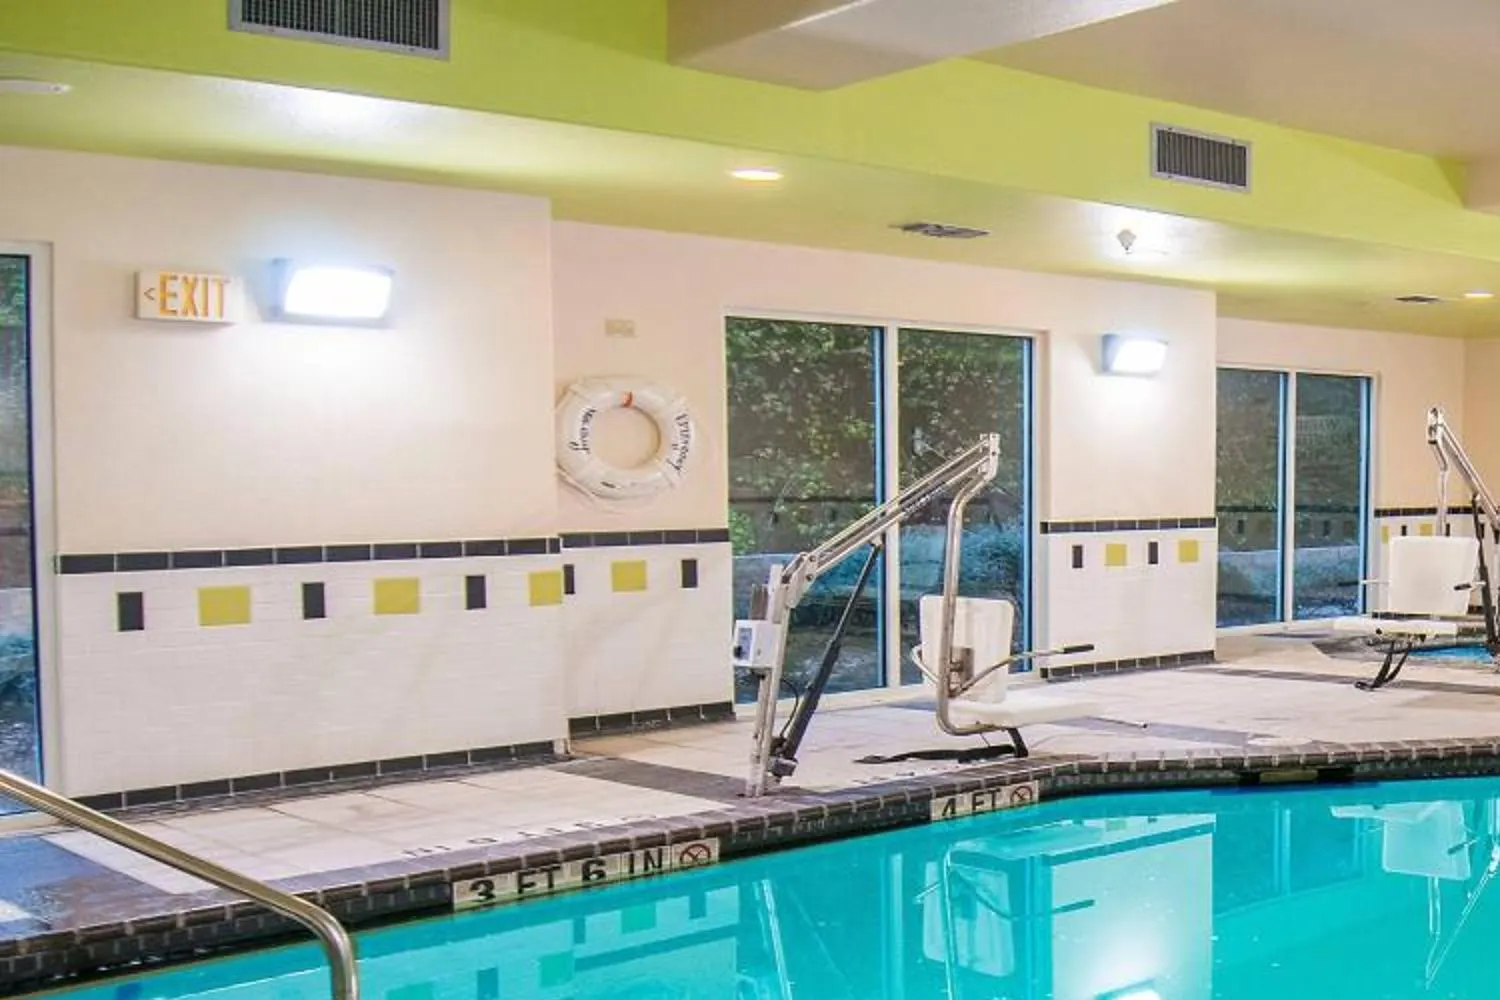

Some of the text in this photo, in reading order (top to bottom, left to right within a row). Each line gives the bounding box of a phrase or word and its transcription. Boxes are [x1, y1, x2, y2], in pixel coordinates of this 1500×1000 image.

[159, 273, 230, 318] EXIT
[941, 790, 1001, 817] 4 FT
[469, 848, 663, 902] 3 FT 6 IN
